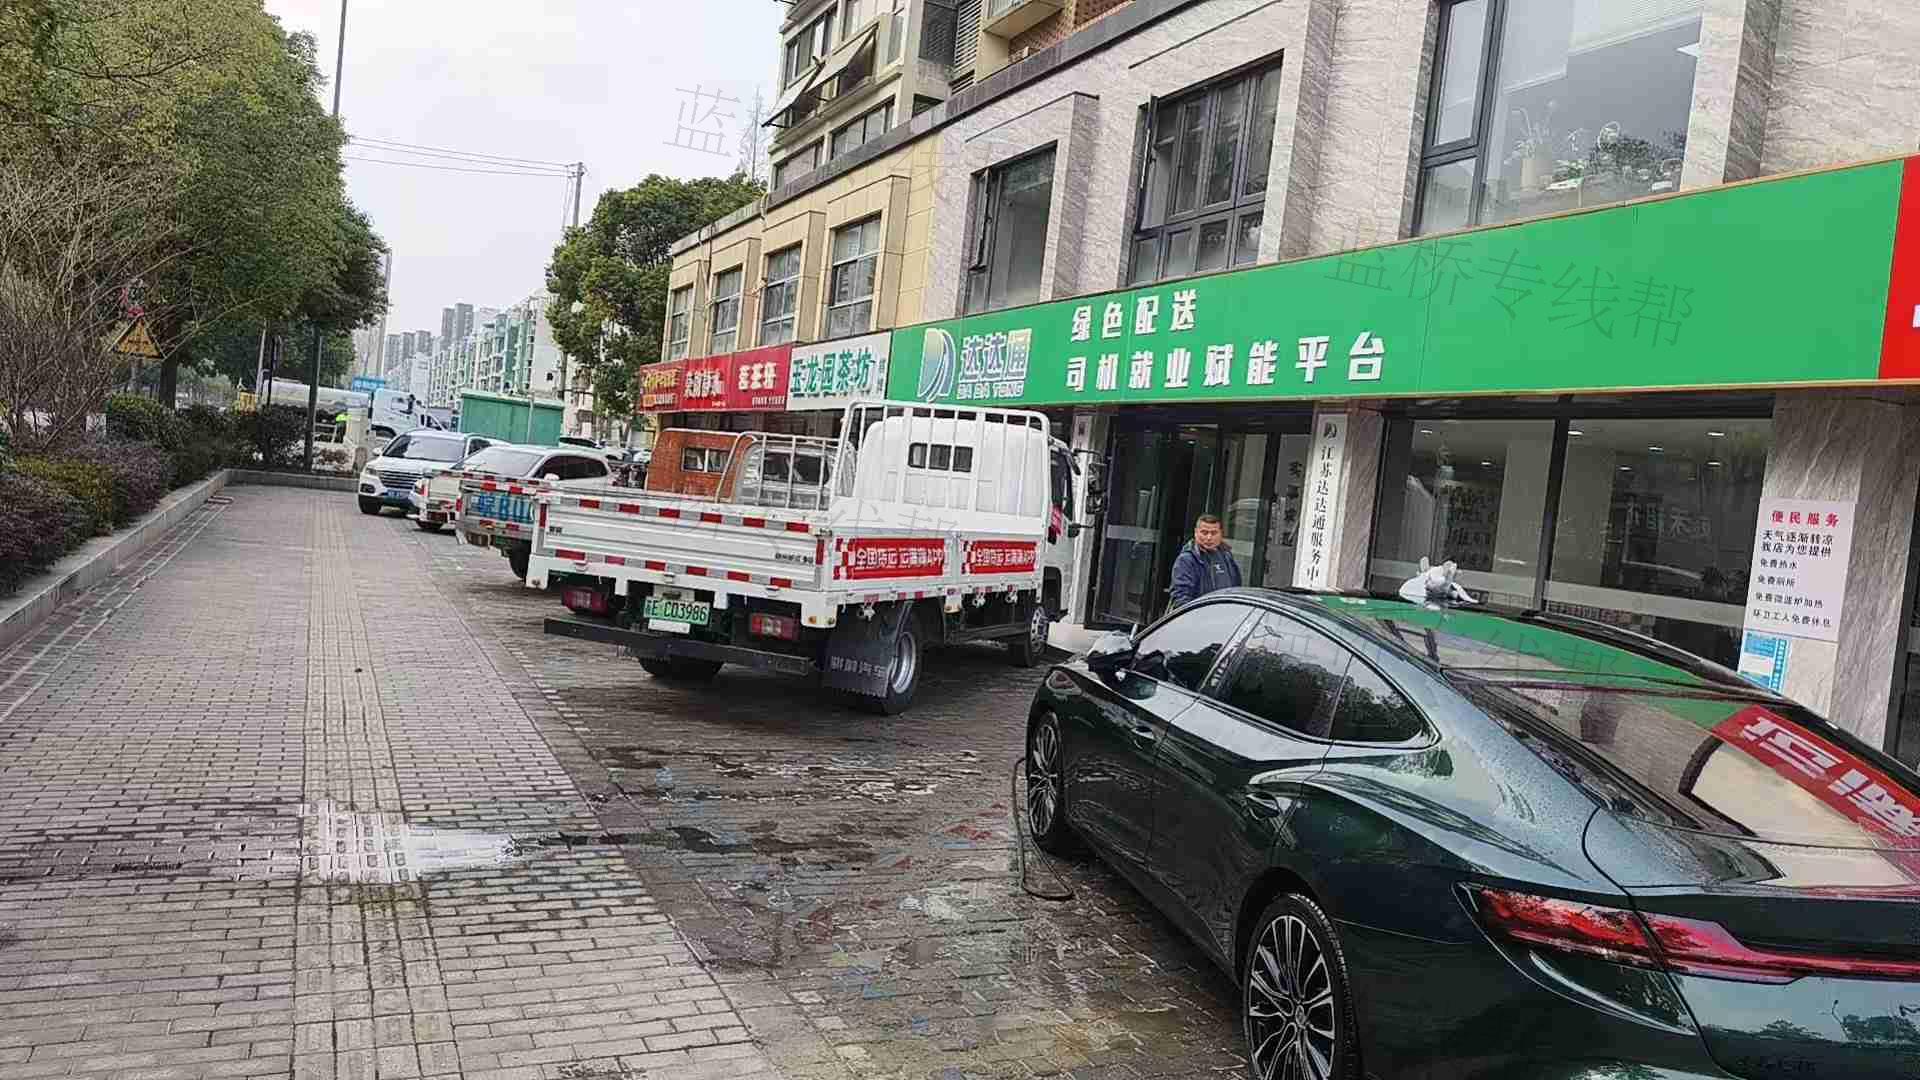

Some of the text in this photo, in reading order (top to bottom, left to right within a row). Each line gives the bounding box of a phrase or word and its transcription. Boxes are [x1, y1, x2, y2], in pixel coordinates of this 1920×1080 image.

[1069, 289, 1198, 343] 绿色配送
[1065, 331, 1387, 393] 司机就业赋能平台
[1770, 510, 1839, 527] 便民服务
[1762, 529, 1833, 545] 天气逐渐转凉
[1761, 542, 1831, 557] 我店为您提供
[1760, 558, 1797, 570] 免费热水
